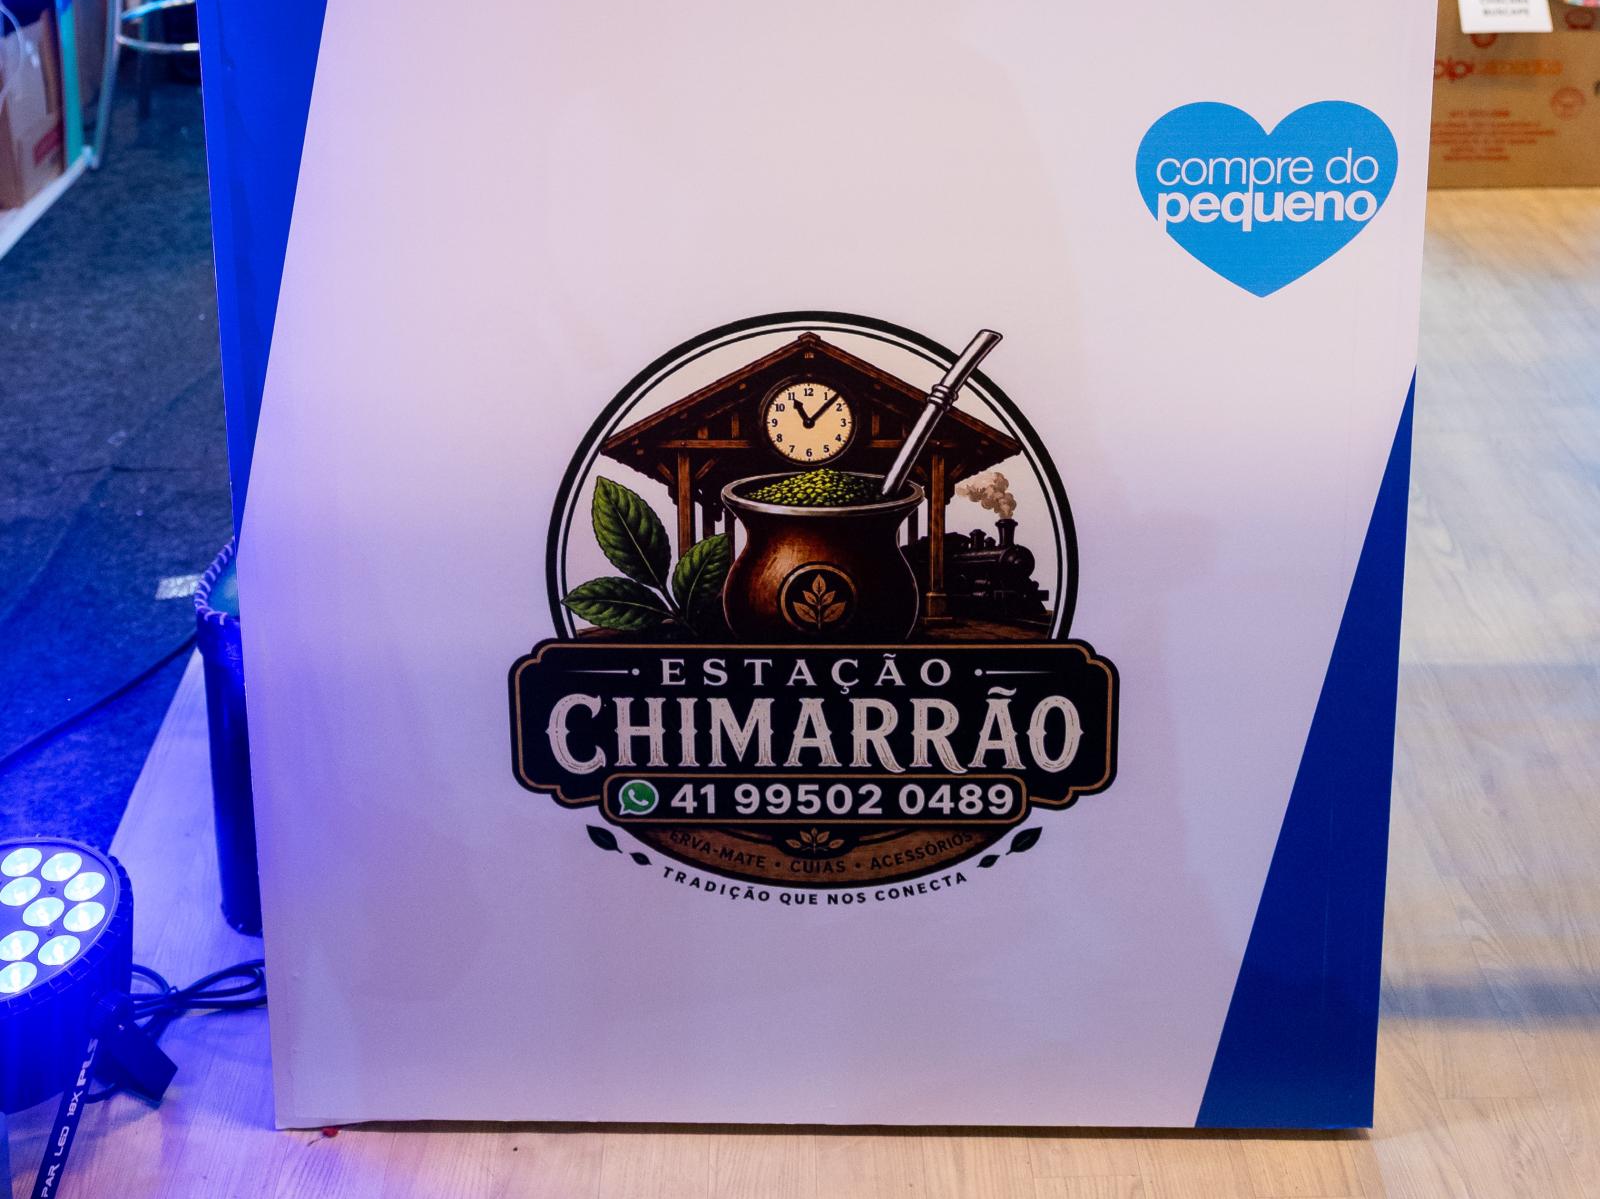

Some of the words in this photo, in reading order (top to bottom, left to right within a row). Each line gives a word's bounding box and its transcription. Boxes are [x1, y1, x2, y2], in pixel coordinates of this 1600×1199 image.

[1156, 156, 1314, 193] compre
[1325, 147, 1379, 185] do
[1157, 190, 1378, 232] pequeno
[787, 392, 796, 400] 11
[804, 388, 814, 397] 12
[824, 392, 828, 400] 1
[775, 403, 785, 412] 10
[836, 403, 843, 412] 2
[771, 418, 778, 427] 9
[840, 418, 847, 427] 3
[776, 434, 783, 442] 8
[835, 434, 842, 442] 4
[789, 445, 796, 453] 7
[806, 448, 812, 457] 6
[823, 444, 830, 453] 5
[660, 653, 951, 694] ESTAÇÃO
[545, 686, 1084, 775] CHIMARRÃO
[670, 784, 716, 814] 41
[734, 783, 882, 815] 99502
[898, 783, 1014, 815] 0489
[669, 829, 767, 868] ERVA-MATE
[790, 859, 846, 874] CUIAS
[869, 832, 974, 870] ACESSÓRIOS
[663, 866, 770, 901] TRADIÇÃO
[779, 892, 818, 906] QUE
[827, 891, 867, 905] NOS
[874, 871, 968, 901] CONECTA
[41, 1163, 60, 1198] PAR
[54, 1126, 70, 1156] LED
[67, 1090, 84, 1117] 18X
